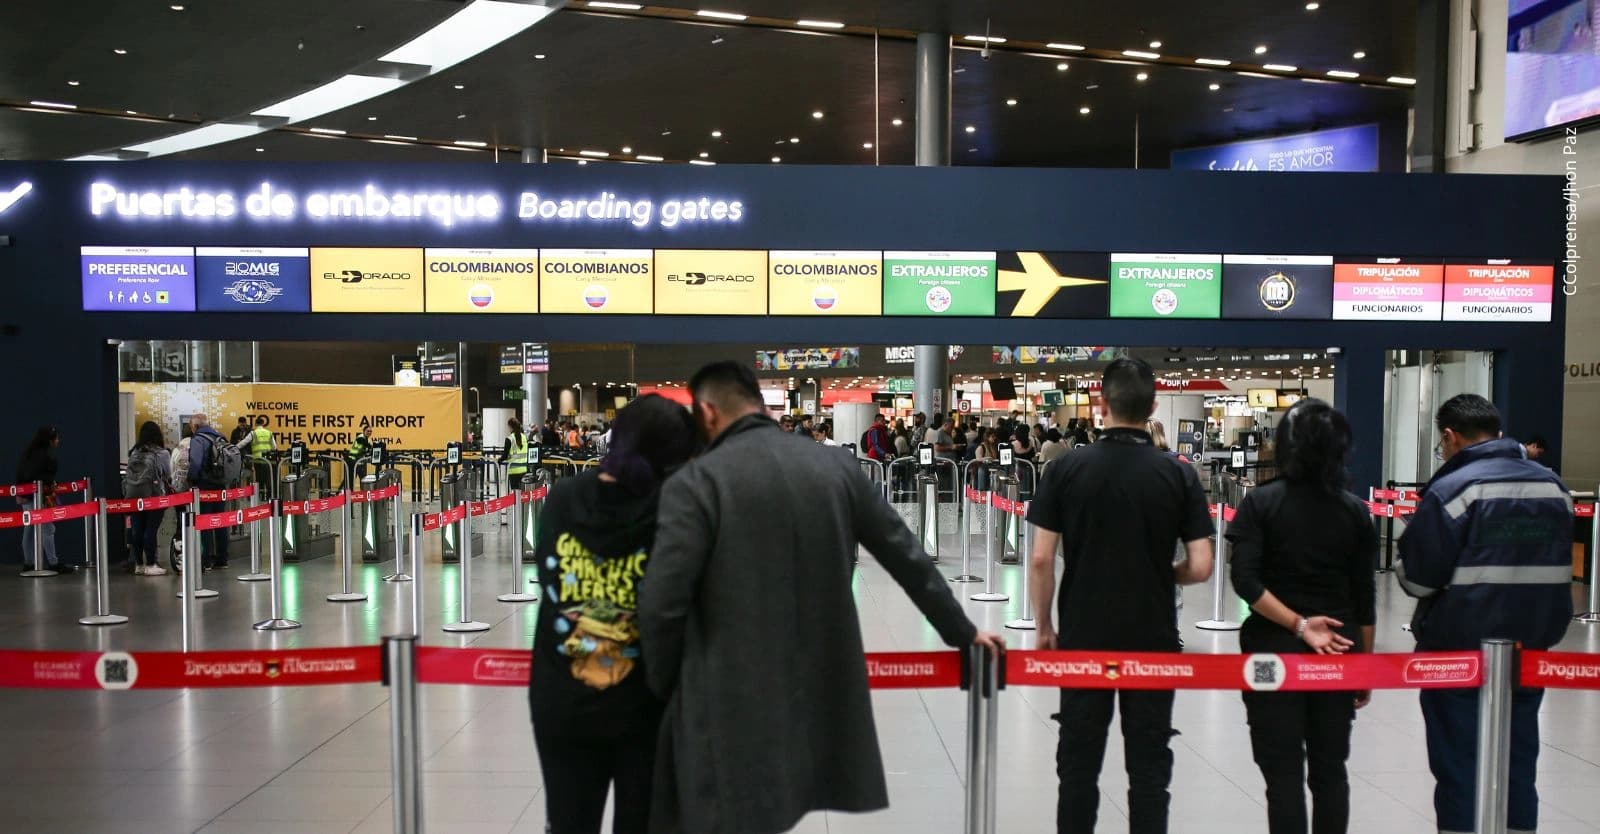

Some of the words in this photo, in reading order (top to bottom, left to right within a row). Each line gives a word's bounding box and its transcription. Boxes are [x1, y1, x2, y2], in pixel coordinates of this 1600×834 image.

[1269, 158, 1284, 171] ES
[1291, 151, 1334, 168] AMOR
[90, 182, 235, 217] Puertas
[245, 182, 294, 217] de
[306, 184, 499, 227] embarque
[519, 191, 651, 227] Boarding
[661, 197, 742, 227] gates
[88, 263, 188, 276] PREFERENCIAL
[225, 262, 280, 273] BIOMIG
[429, 261, 534, 274] COLOMBIANOS
[544, 262, 649, 275] COLOMBIANOS
[773, 264, 878, 276] COLOMBIANOS
[891, 265, 989, 278] EXTRANJEROS
[1357, 265, 1420, 277] TRIPULACIÓN
[1468, 266, 1530, 278] TRIPULACIÓN
[323, 272, 342, 280] EL
[667, 274, 685, 282] EL
[1118, 267, 1214, 281] EXTRANJEROS
[1352, 285, 1424, 296] DIPLOMÁTICOS
[1463, 286, 1534, 297] DIPLOMÁTICOS
[1352, 304, 1424, 313] FUNCIONARIOS
[1462, 305, 1533, 315] FUNCIONARIOS
[246, 402, 299, 410] WELCOME
[246, 414, 270, 428] TO
[275, 414, 307, 428] THE
[312, 415, 355, 428] FIRST
[359, 415, 425, 428] AIRPORT
[273, 432, 301, 445] THE
[283, 657, 356, 673] Alemana
[1122, 660, 1193, 676] Alemana
